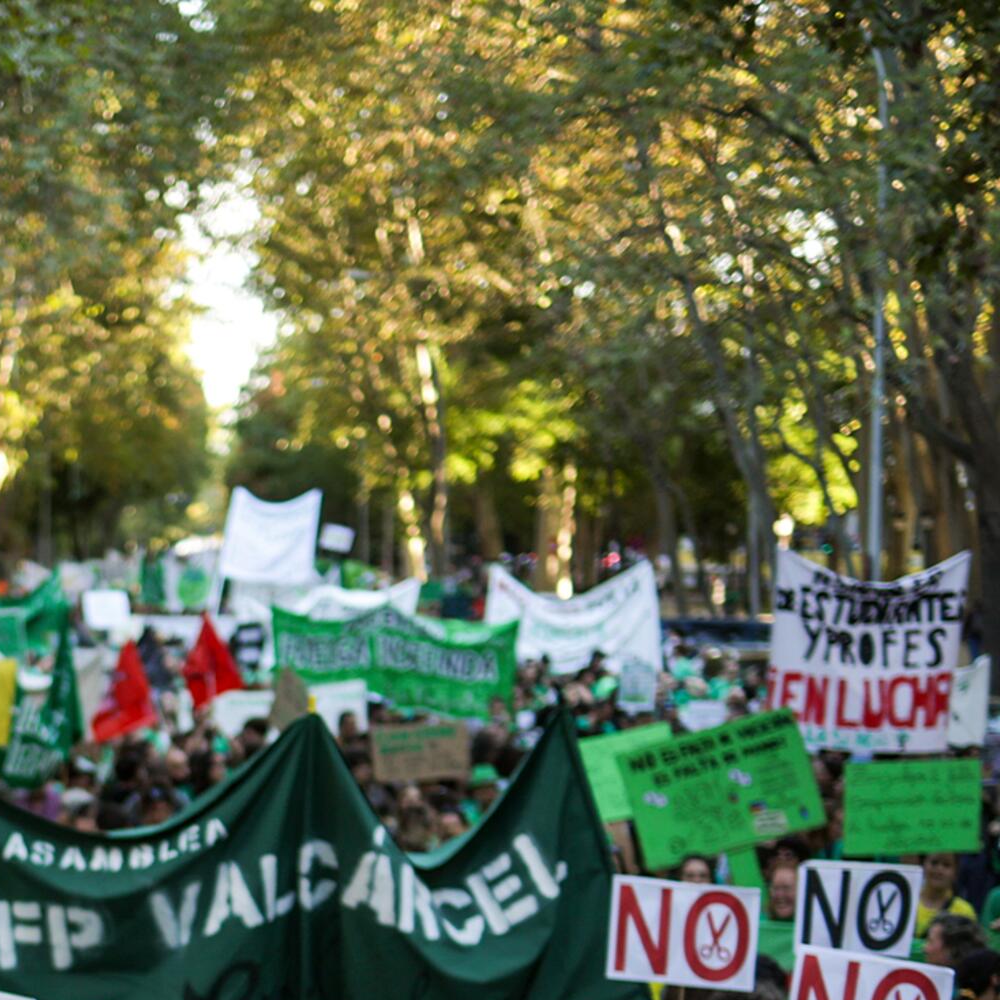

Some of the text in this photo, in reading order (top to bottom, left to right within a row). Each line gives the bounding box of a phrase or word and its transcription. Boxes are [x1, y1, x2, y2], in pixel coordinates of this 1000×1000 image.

[3, 818, 229, 872] ASAMBLEA
[614, 884, 751, 982] NO
[802, 868, 912, 952] NO
